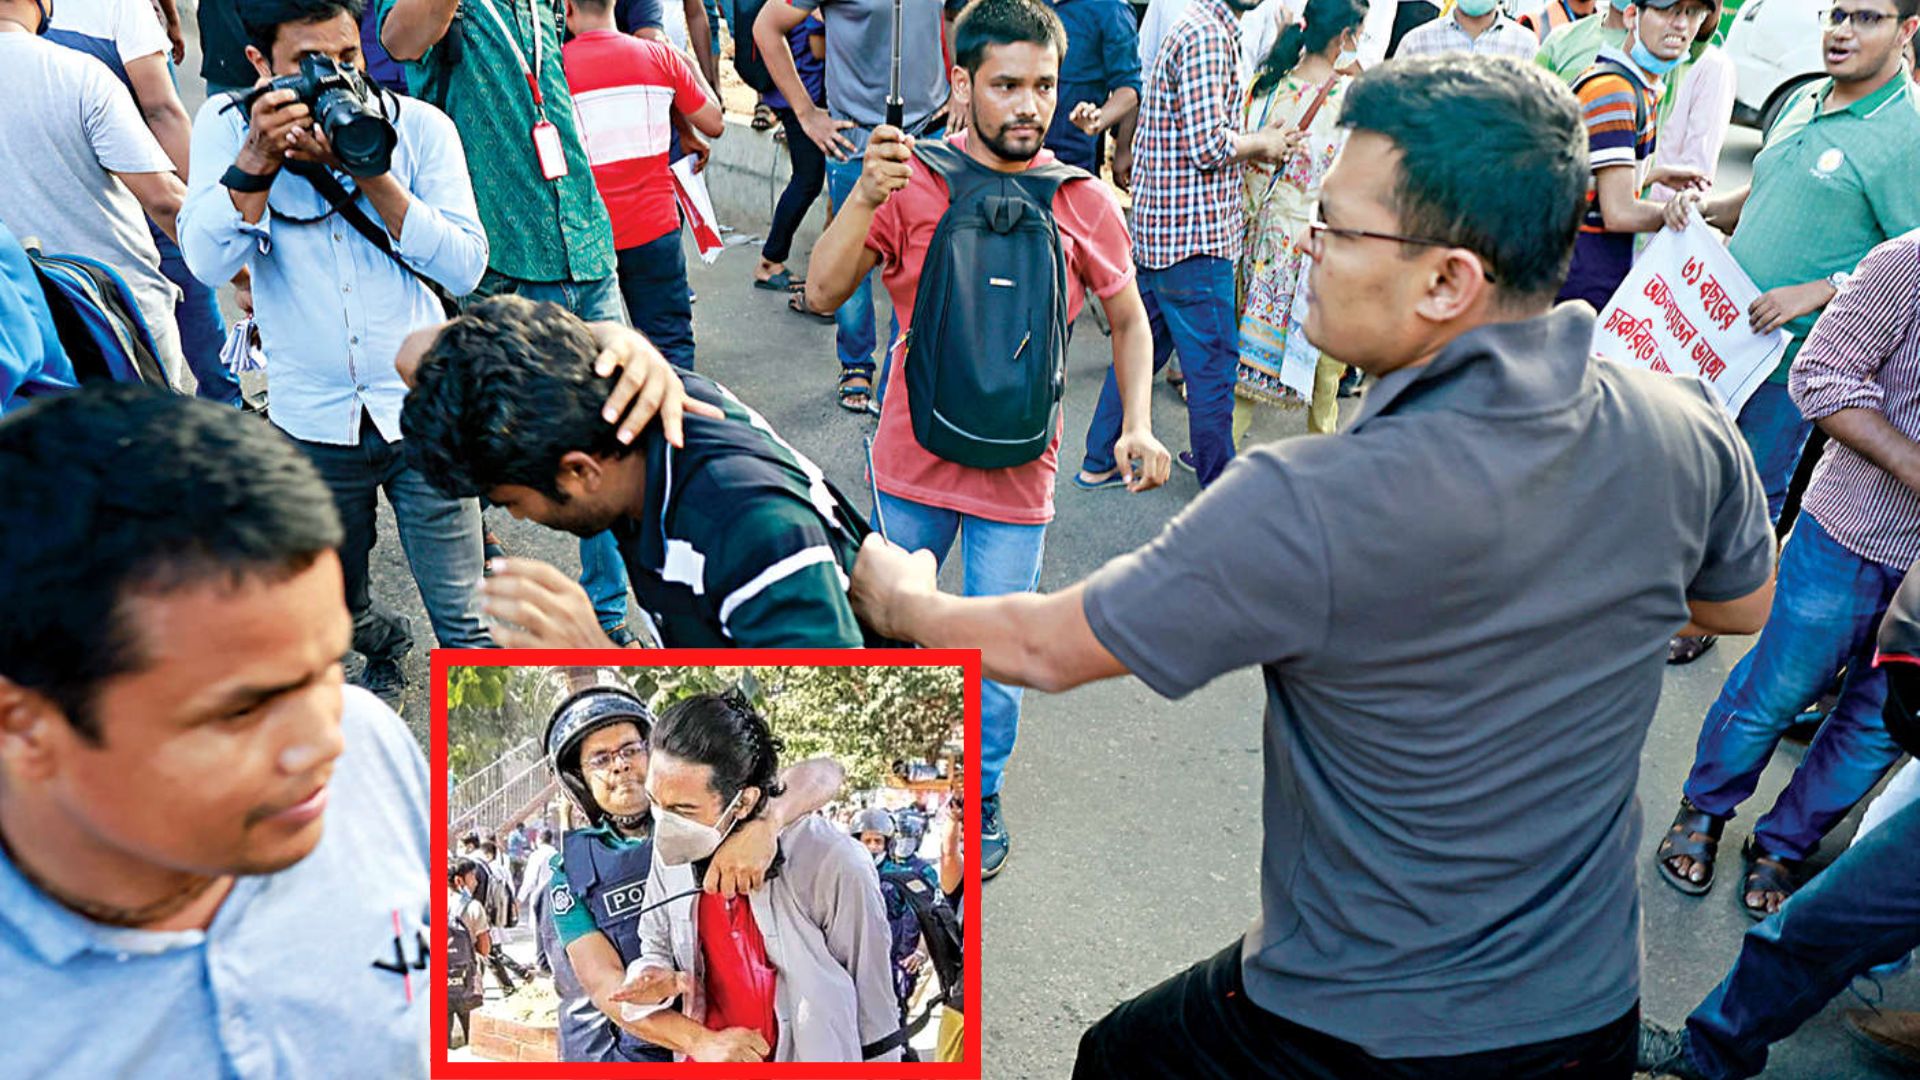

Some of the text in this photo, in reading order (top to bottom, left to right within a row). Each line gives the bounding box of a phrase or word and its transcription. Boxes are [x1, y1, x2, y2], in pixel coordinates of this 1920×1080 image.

[1699, 273, 1740, 331] বছরের
[1603, 307, 1660, 361] চাকরিতে
[612, 887, 645, 910] PO
